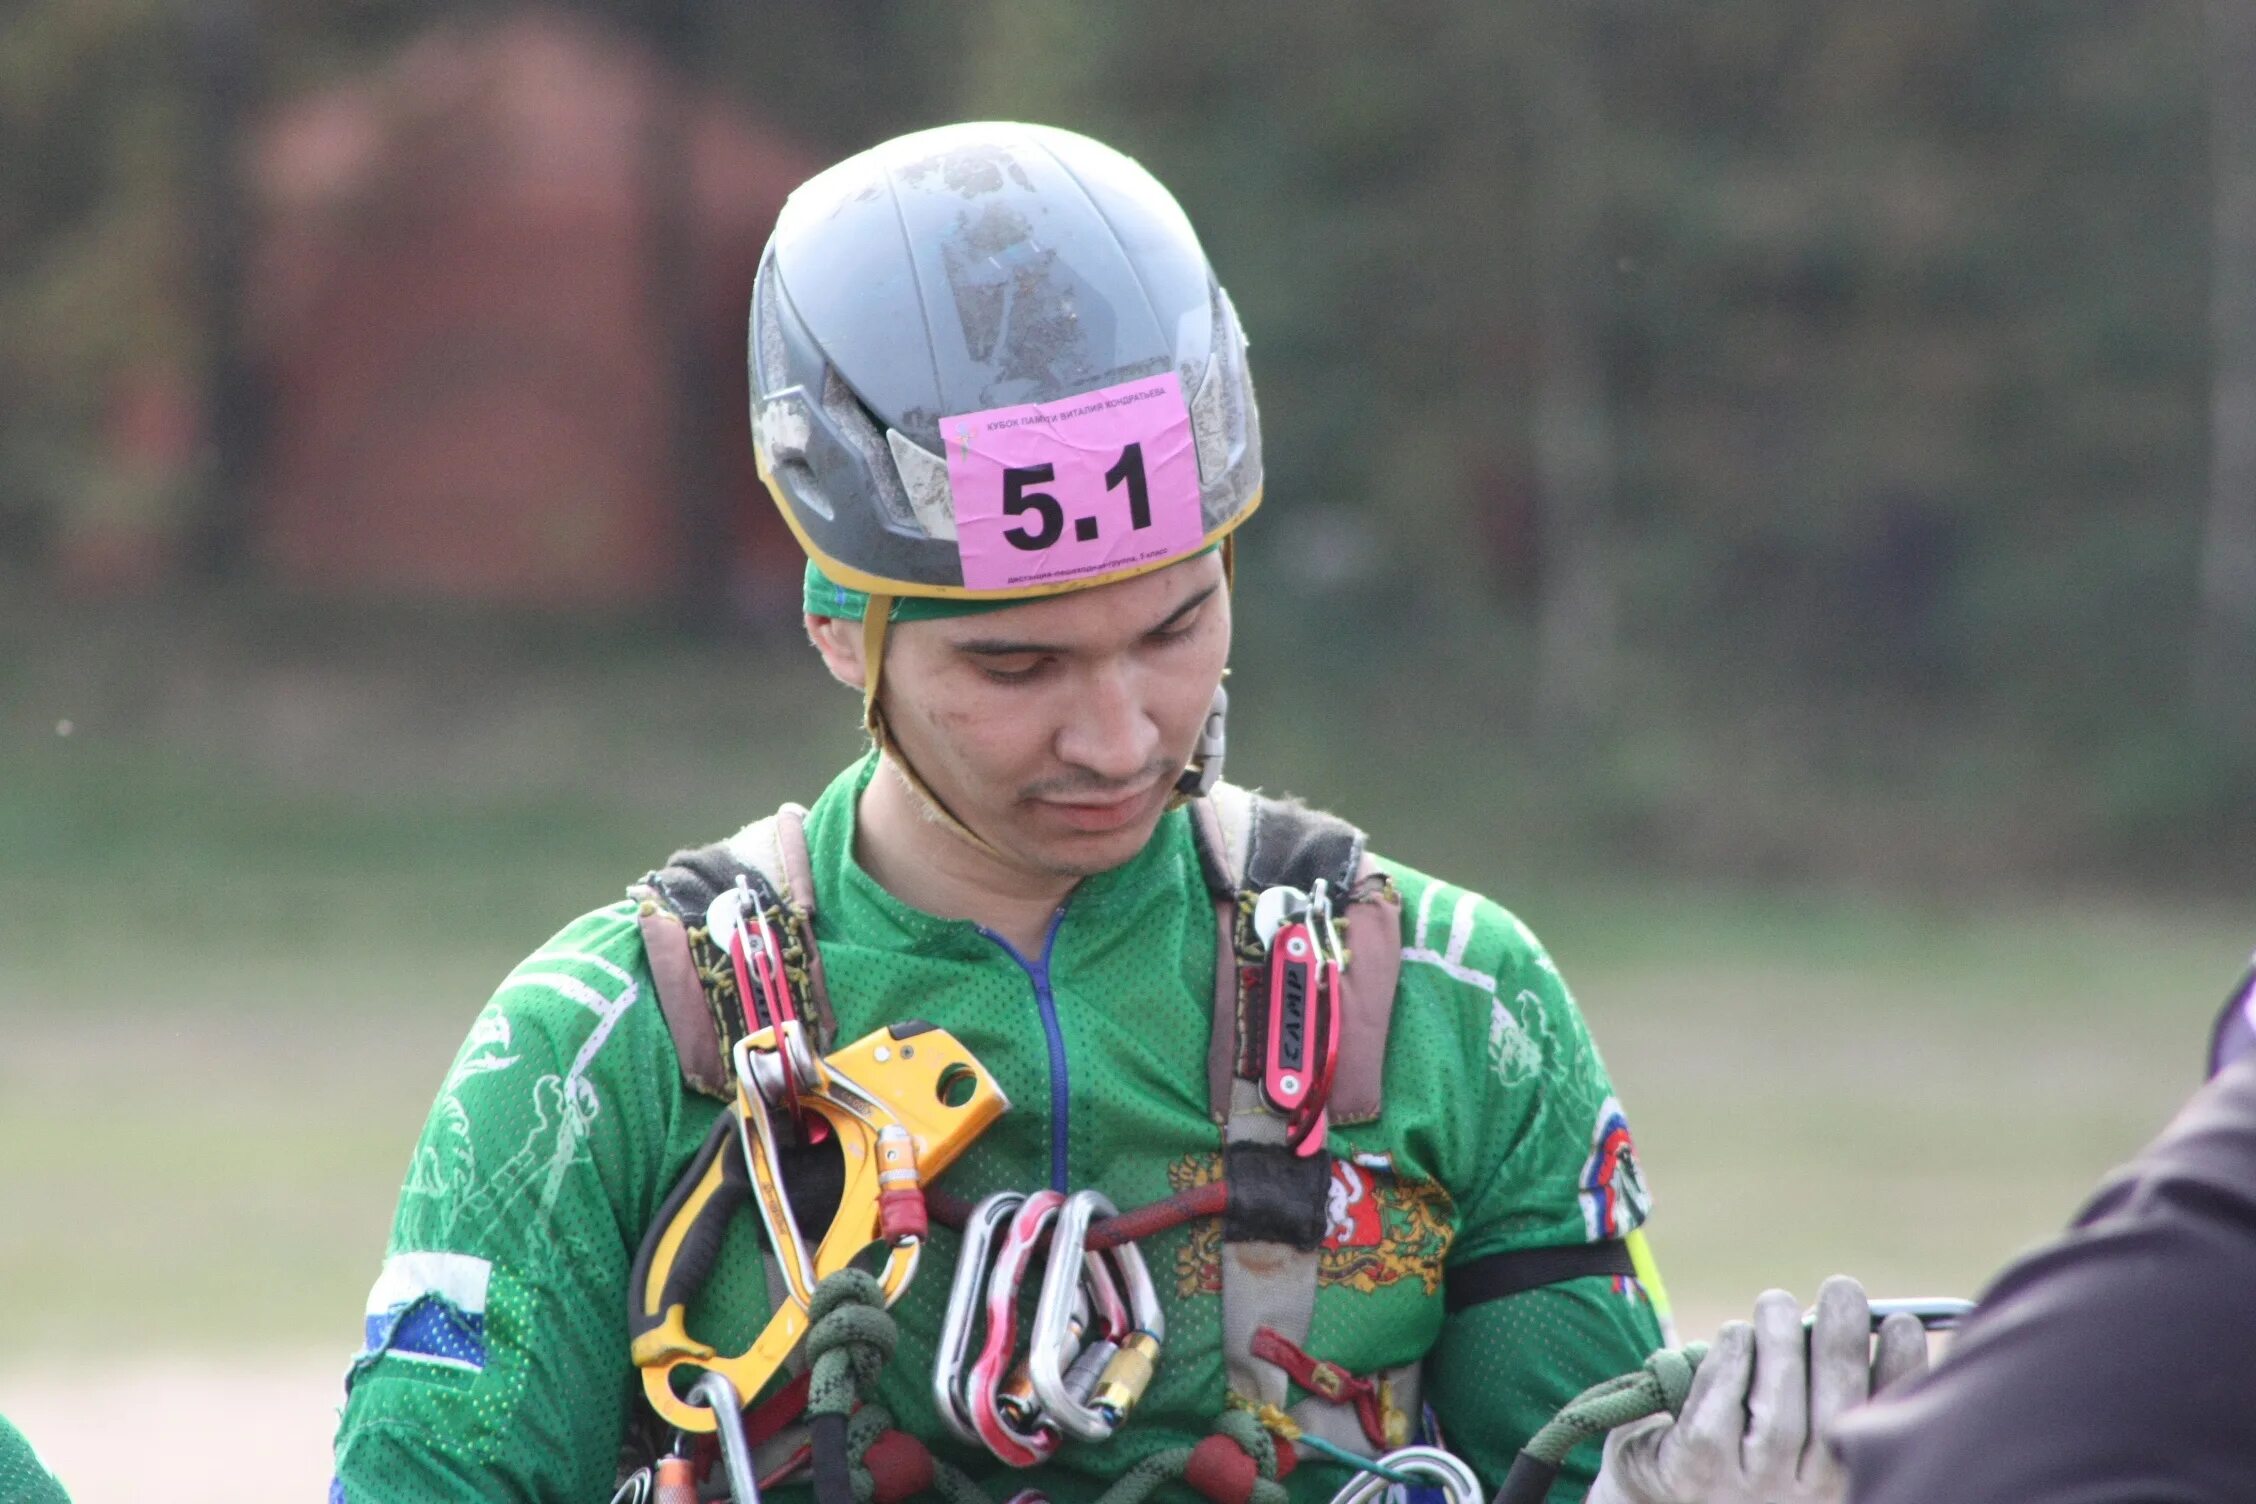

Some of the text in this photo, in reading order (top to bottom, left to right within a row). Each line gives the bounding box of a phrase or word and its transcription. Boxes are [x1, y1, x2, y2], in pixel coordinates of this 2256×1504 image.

[987, 418, 1019, 431] КУБОК
[1060, 403, 1104, 420] ВИТАЛИЯ
[1105, 387, 1167, 408] КОНДРАТЬЕВА
[1002, 442, 1152, 551] 5.1
[1146, 547, 1168, 558] класс
[1284, 968, 1303, 1062] CAMP
